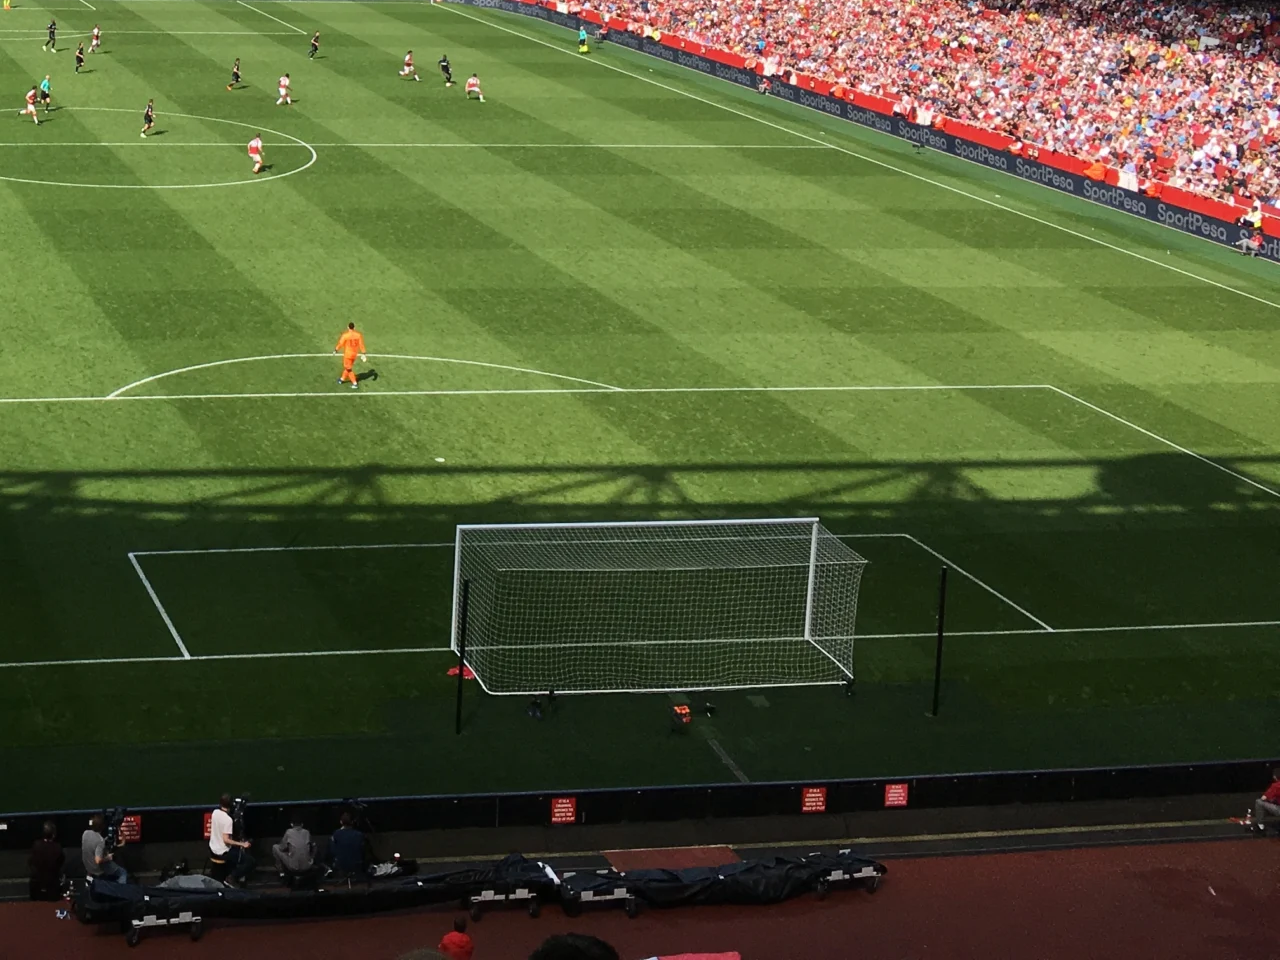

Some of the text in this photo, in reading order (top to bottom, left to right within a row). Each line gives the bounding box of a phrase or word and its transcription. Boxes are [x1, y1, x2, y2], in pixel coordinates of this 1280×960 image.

[642, 40, 674, 58] SportPesa
[678, 52, 710, 72] SportPesa
[716, 63, 750, 86] SportPesa
[800, 90, 840, 114] SportPesa
[847, 105, 892, 131] SportPesa
[898, 121, 948, 149] SportPesa
[954, 139, 1008, 170] SportPesa
[1016, 158, 1074, 191] SportPesa
[1083, 180, 1146, 214] SportPesa
[1158, 204, 1227, 240] SportPesa
